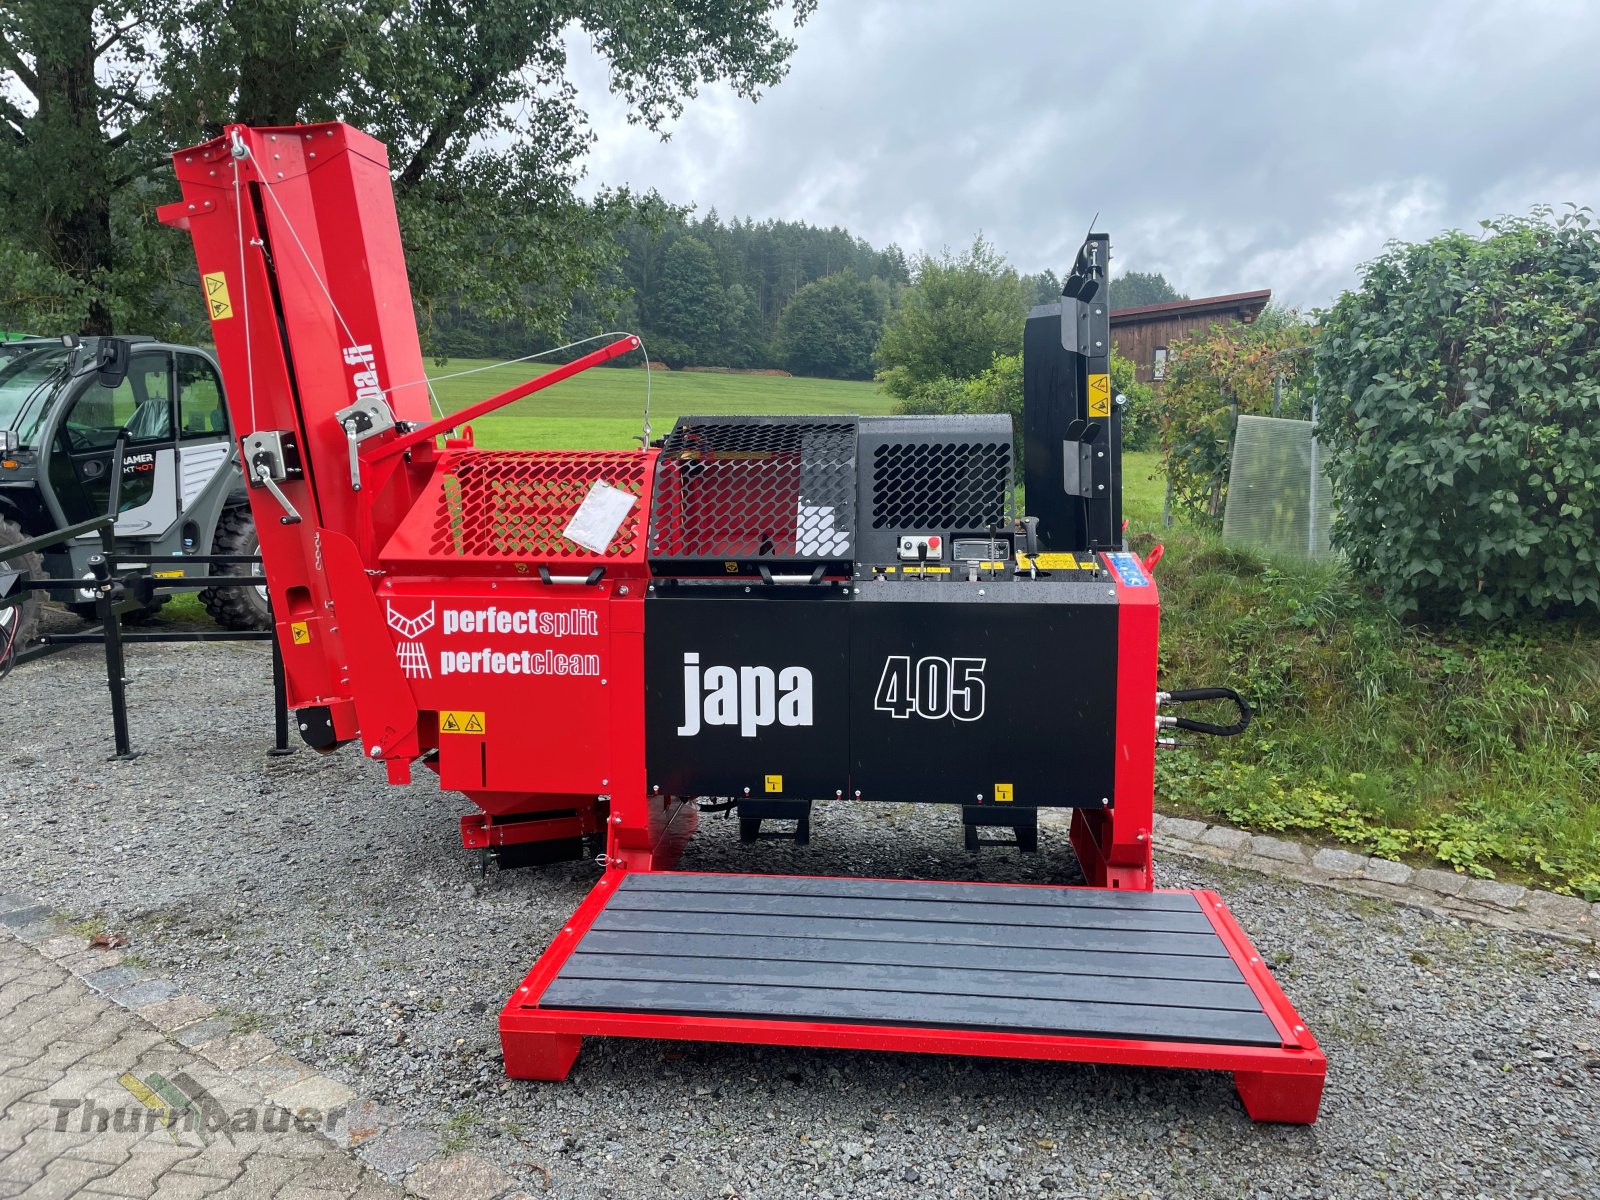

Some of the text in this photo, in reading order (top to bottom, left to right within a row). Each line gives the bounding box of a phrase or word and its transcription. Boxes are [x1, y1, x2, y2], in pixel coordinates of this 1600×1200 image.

[343, 344, 386, 401] pa.fi
[112, 453, 154, 465] AMER
[443, 606, 599, 637] perfectsplit
[440, 648, 599, 676] perfectclean
[677, 652, 813, 738] japa
[874, 655, 987, 722] 405
